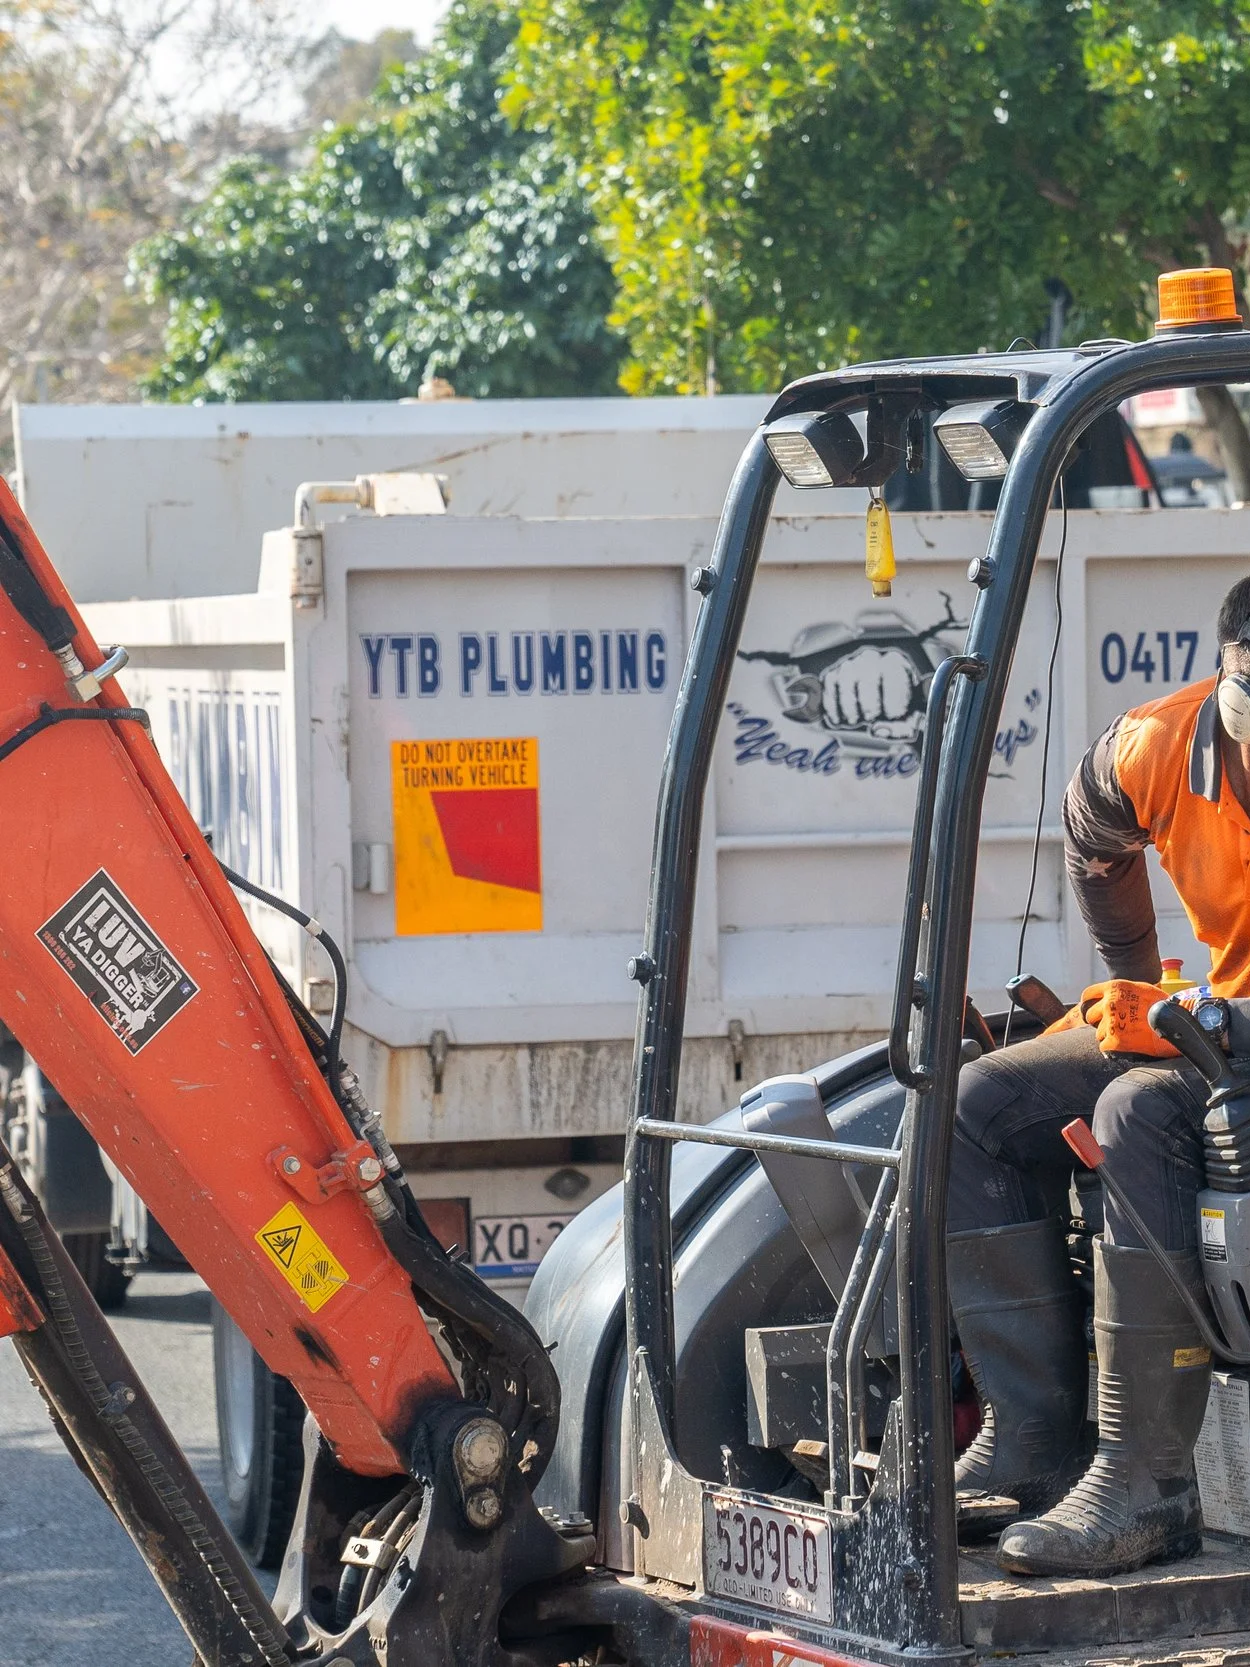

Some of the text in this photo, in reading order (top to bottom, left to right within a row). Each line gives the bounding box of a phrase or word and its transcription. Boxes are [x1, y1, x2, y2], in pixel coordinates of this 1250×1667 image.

[358, 629, 669, 699] YTB PLUMBING
[1101, 631, 1198, 683] 0417
[400, 740, 528, 764] DO NOT OVERTAKE
[403, 764, 528, 788] TURNING VEHICLE
[84, 900, 146, 968] LUV
[71, 924, 94, 955] YA
[90, 950, 146, 1010] DIGGER
[775, 1590, 792, 1607] USE
